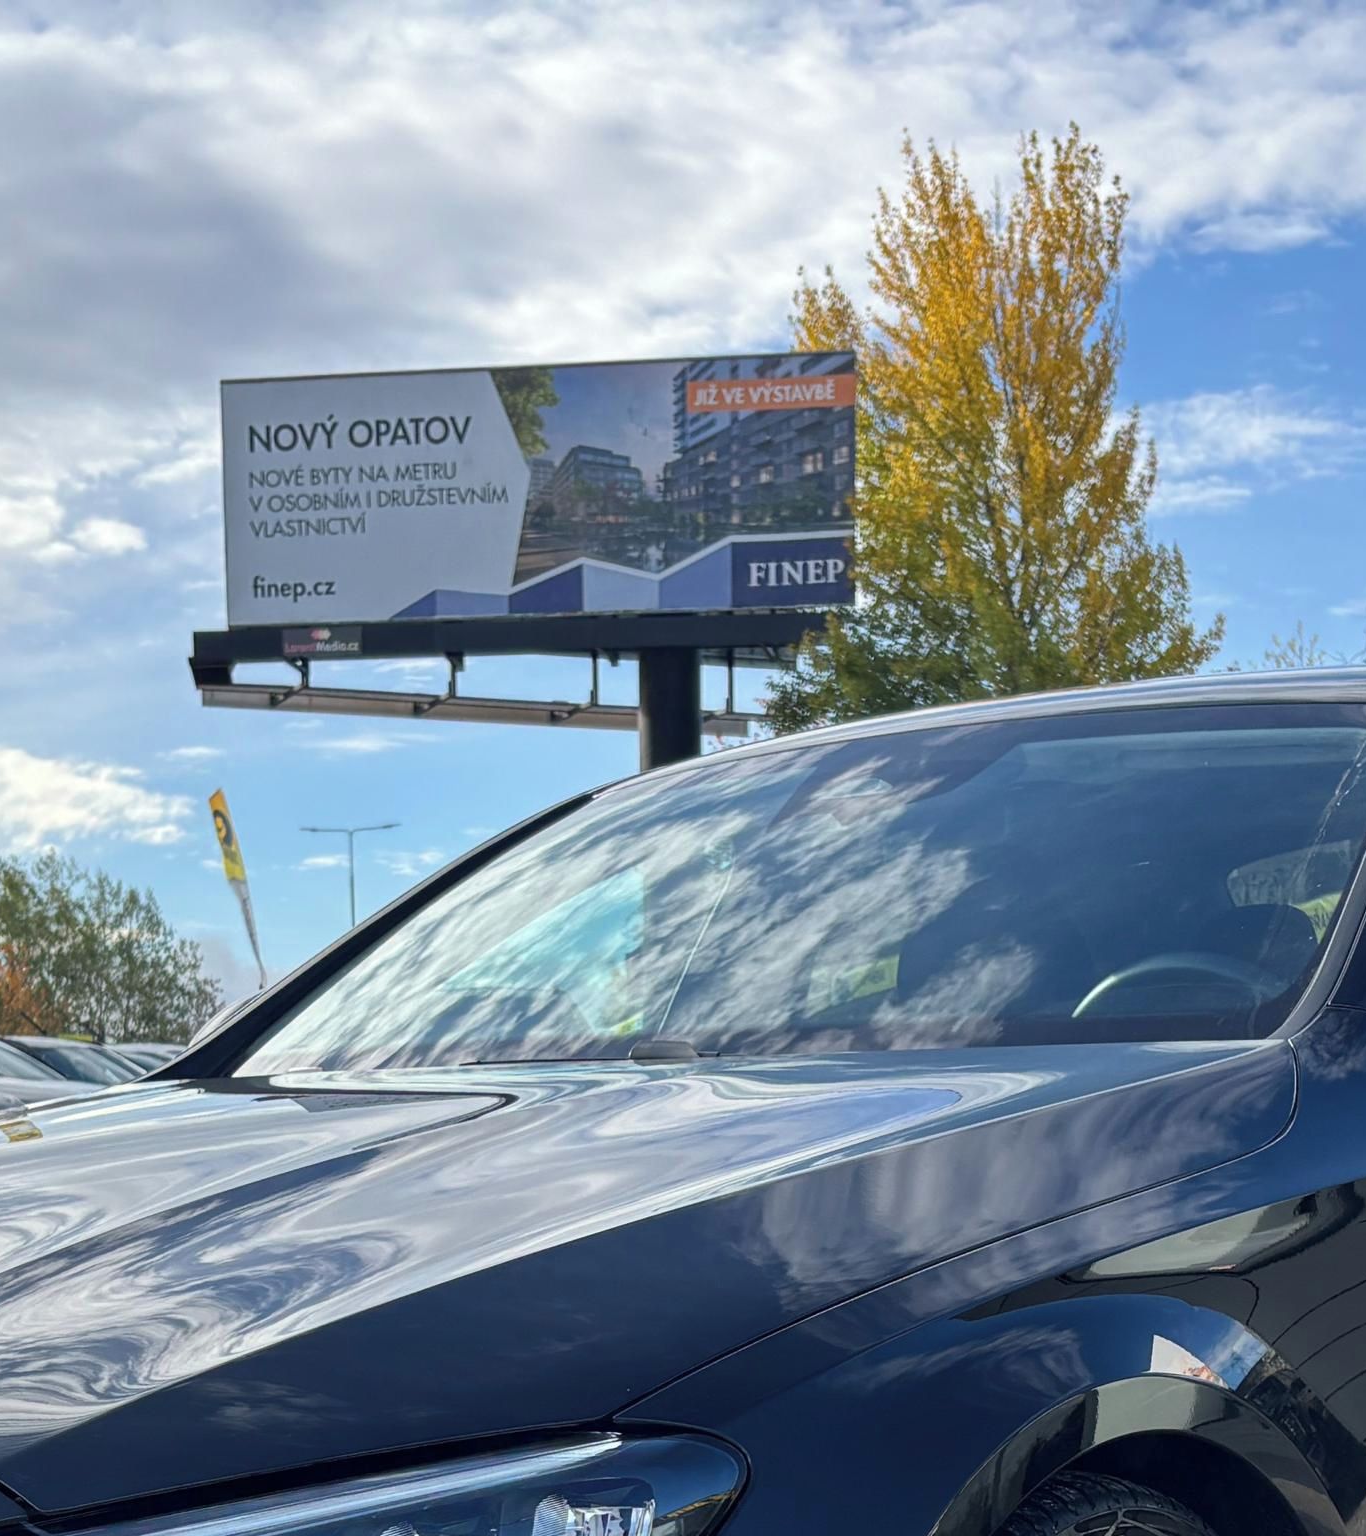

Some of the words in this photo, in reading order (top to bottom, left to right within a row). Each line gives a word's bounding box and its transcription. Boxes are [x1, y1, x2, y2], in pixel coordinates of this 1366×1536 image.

[694, 383, 718, 406] JIŽ
[722, 388, 745, 405] VE
[749, 379, 836, 405] VÝSTAVBĚ
[249, 414, 339, 452] NOVÝ
[348, 416, 472, 448] OPATOV
[248, 464, 305, 489] NOVÉ
[310, 466, 353, 486] BYTY
[358, 466, 389, 484] NA
[393, 461, 457, 482] METRU
[249, 495, 264, 513] V
[267, 488, 362, 513] OSOBNÍM
[366, 490, 372, 508] I
[377, 484, 509, 509] DRUŽSTEVNÍM
[249, 512, 366, 538] VLASTNICTVÍ
[747, 558, 845, 587] FINEP
[252, 575, 336, 602] finep.cz
